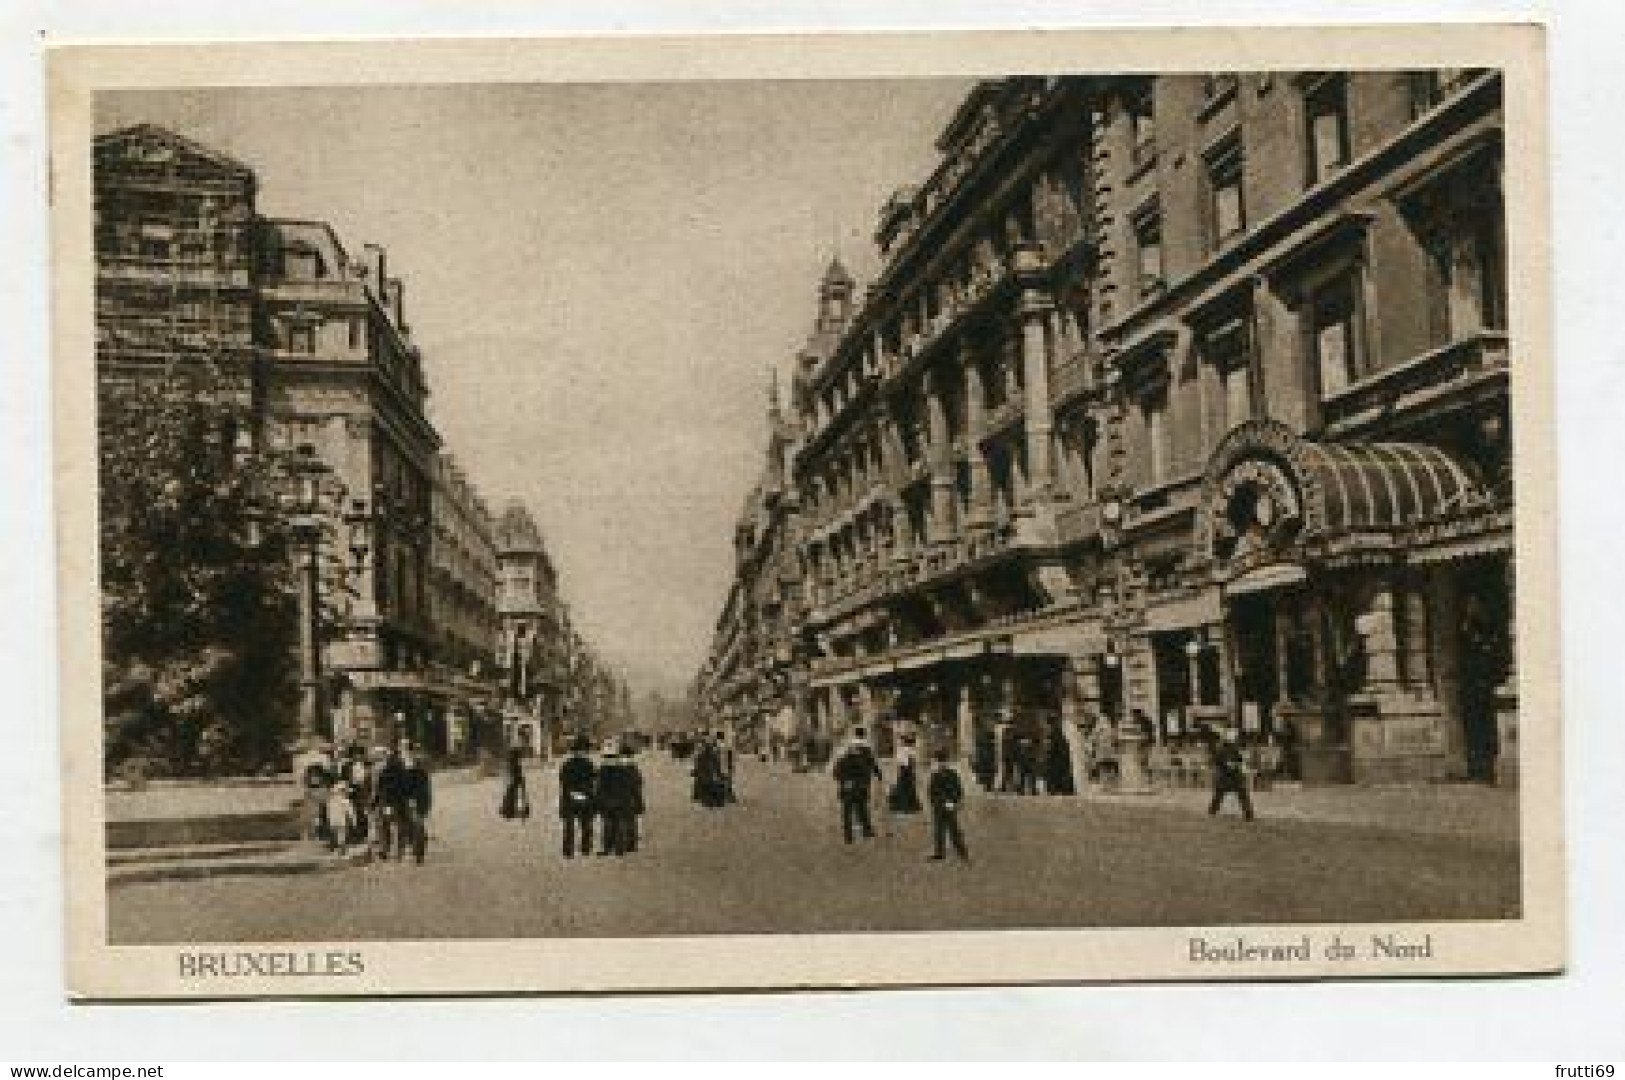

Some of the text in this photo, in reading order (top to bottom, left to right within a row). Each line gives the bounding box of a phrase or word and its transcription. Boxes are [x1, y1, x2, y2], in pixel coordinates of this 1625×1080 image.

[1189, 935, 1432, 962] Boulevard du Nord
[179, 952, 365, 976] BRUXELLES
